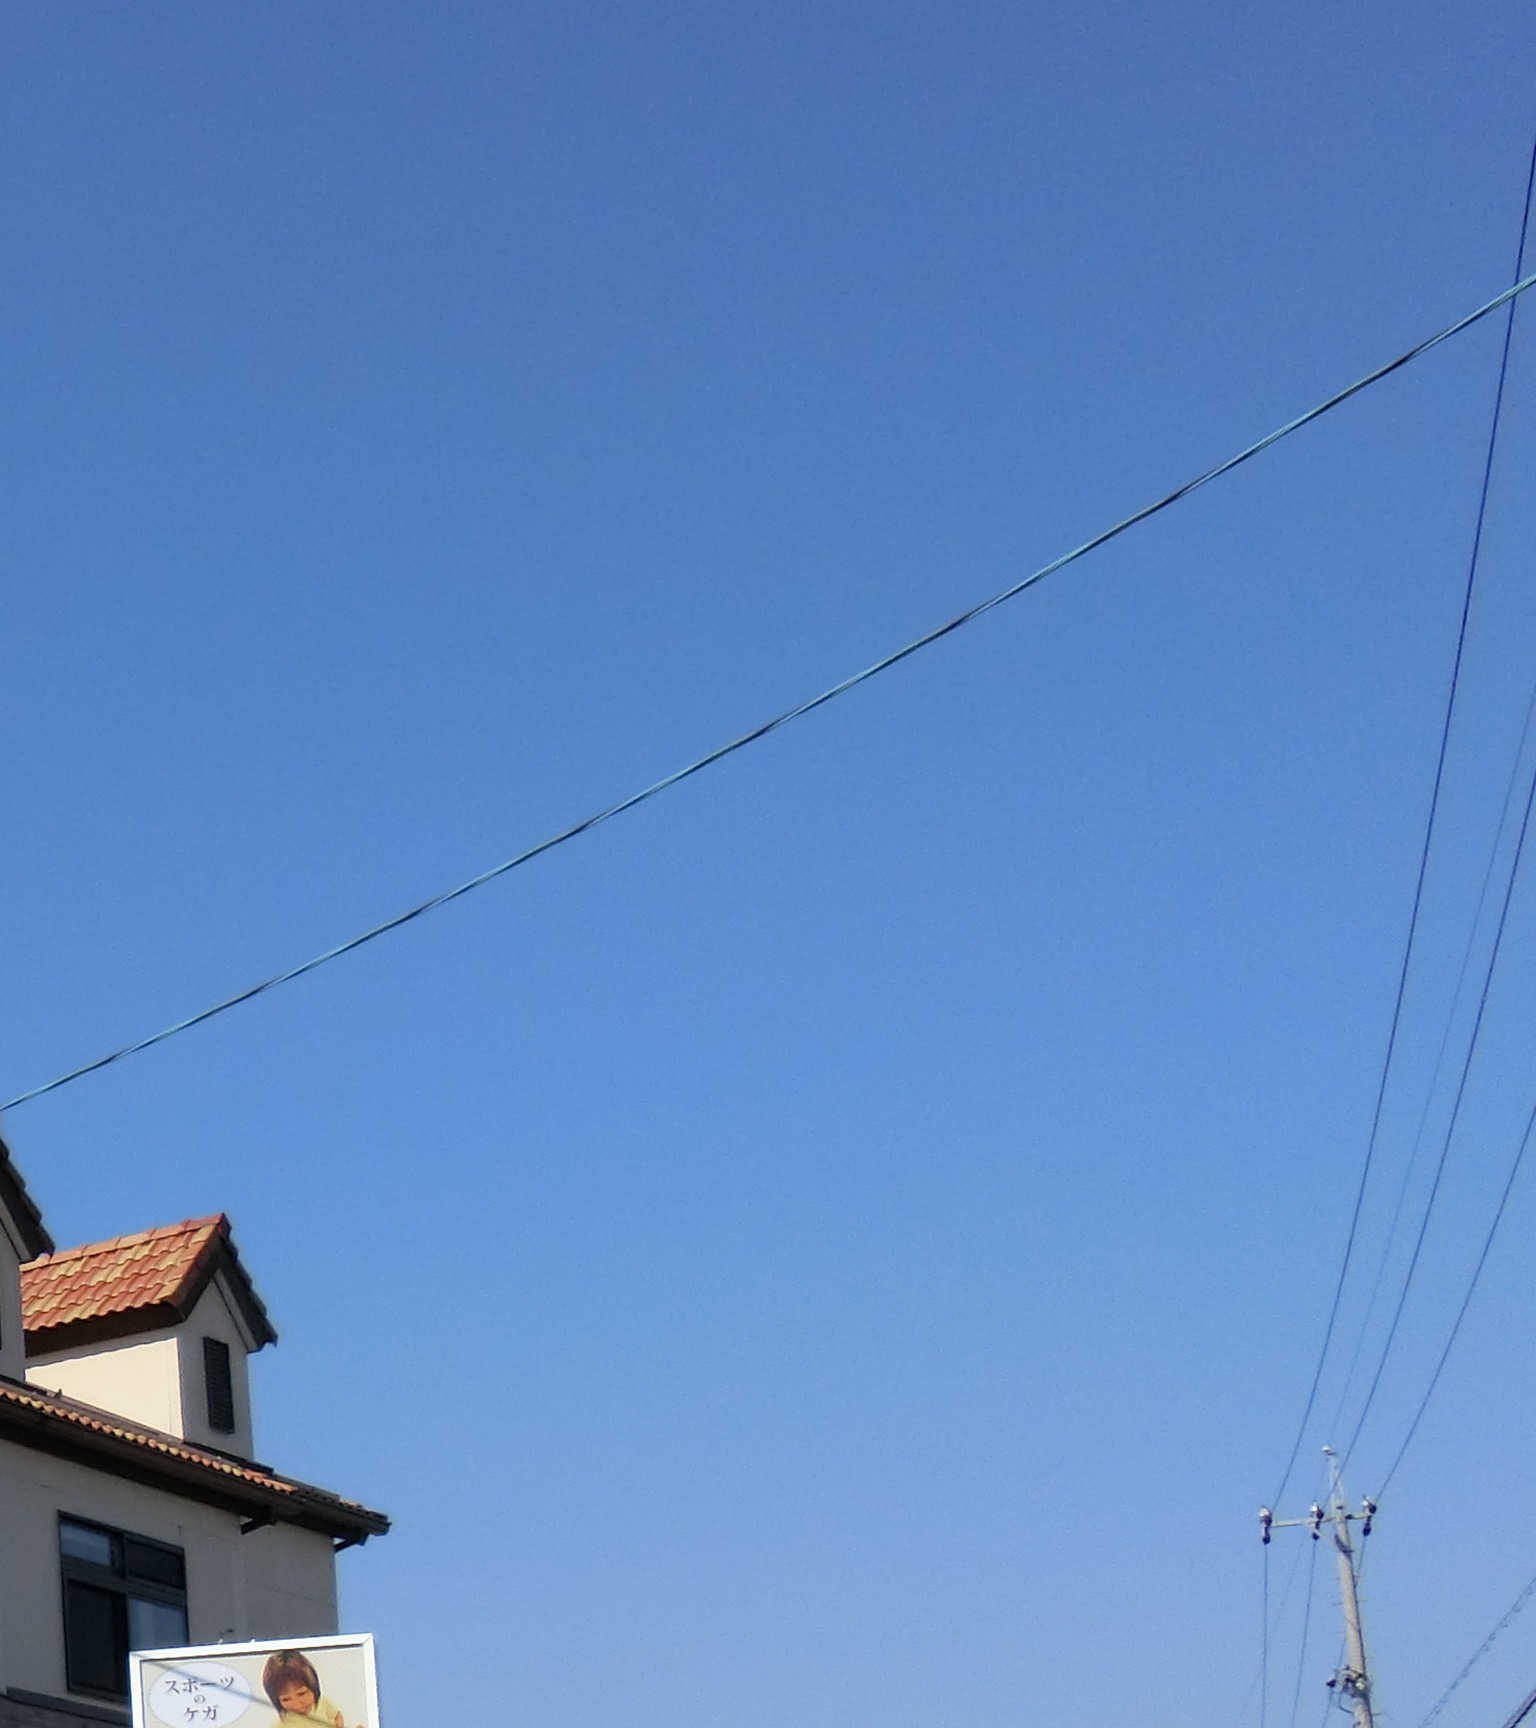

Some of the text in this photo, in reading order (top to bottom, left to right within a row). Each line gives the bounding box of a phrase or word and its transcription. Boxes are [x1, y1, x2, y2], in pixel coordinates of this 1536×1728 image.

[164, 1676, 235, 1695] スポーツ
[193, 1694, 206, 1704] の
[184, 1704, 218, 1723] ケガ
